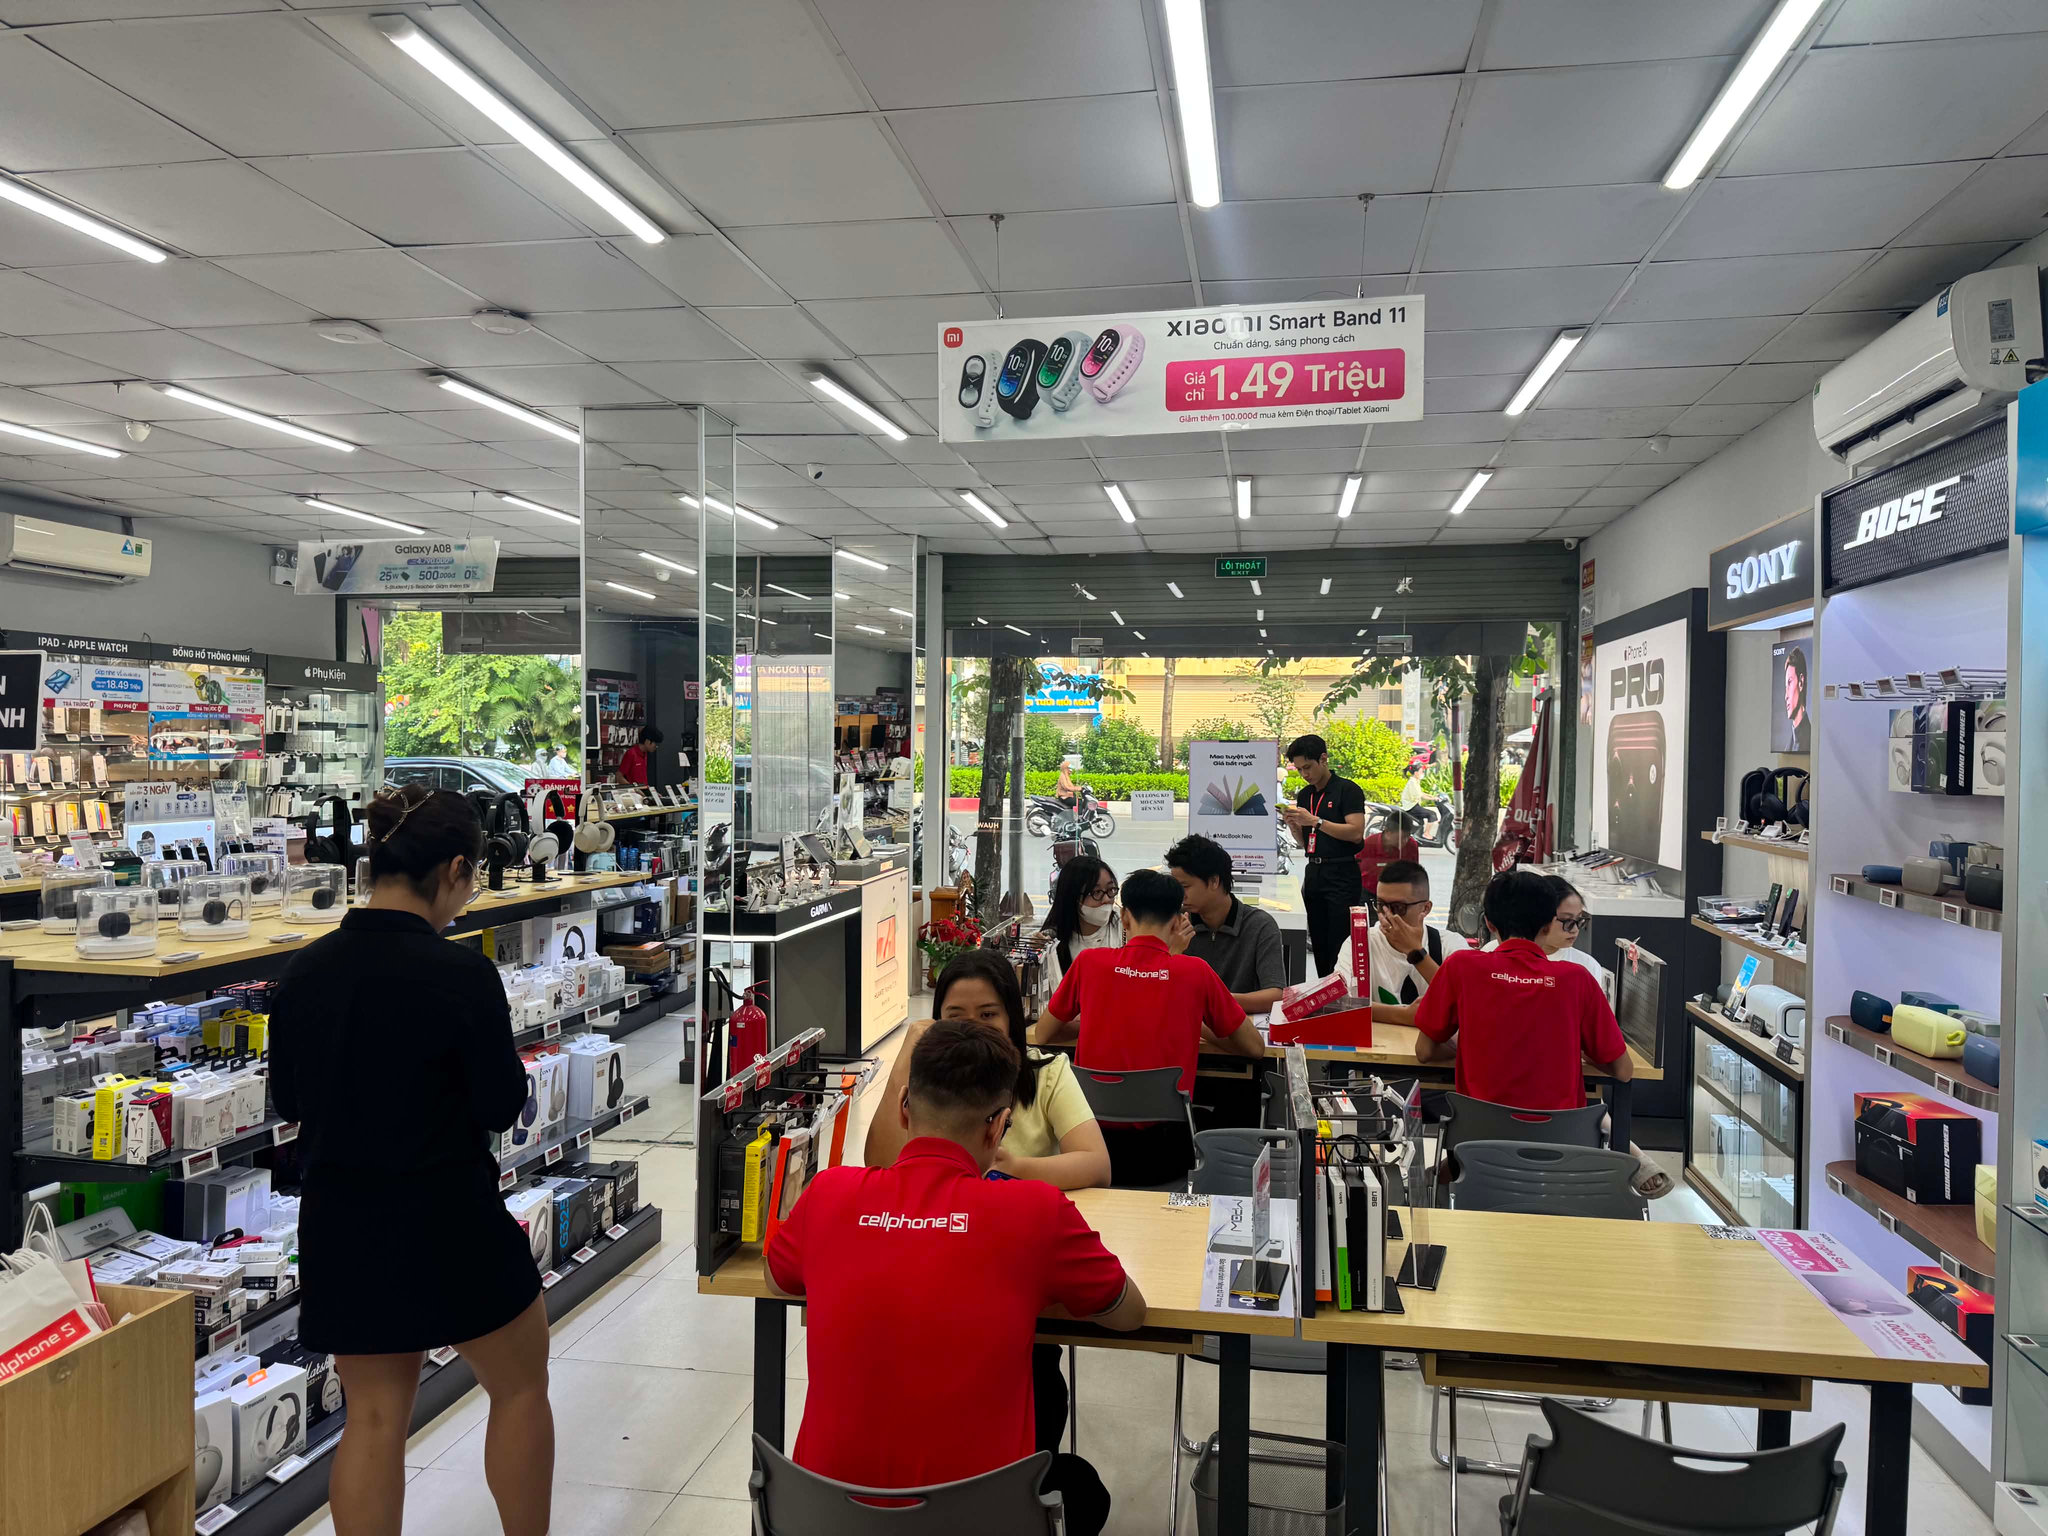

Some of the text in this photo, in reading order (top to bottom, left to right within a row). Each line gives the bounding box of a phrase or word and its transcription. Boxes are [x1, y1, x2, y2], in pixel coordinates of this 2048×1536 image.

[1269, 313, 1326, 331] Smart
[1332, 308, 1382, 327] Band
[1389, 307, 1406, 323] 11
[1246, 337, 1272, 349] dáng,
[1274, 336, 1296, 348] sáng
[1300, 335, 1330, 347] phong
[1332, 334, 1355, 344] cách
[1184, 371, 1206, 385] Giá
[1209, 361, 1386, 401] 1.49 Triệu
[1184, 388, 1205, 402] chỉ
[1179, 414, 1199, 423] Giảm
[1200, 413, 1220, 422] thêm
[1221, 412, 1258, 421] 100.000đ
[1278, 410, 1294, 418] kèm
[1295, 408, 1314, 418] Điện
[1363, 404, 1390, 413] Xiaomi
[1843, 476, 1960, 550] BOSE
[395, 544, 451, 555] Galaxy A08
[1221, 560, 1261, 570] LỐI THOÁT
[1727, 540, 1800, 599] SONY
[38, 637, 59, 647] IPAD
[68, 640, 95, 650] APPLE
[98, 642, 128, 652] WATCH
[1774, 648, 1786, 656] SONY
[173, 647, 250, 662] ĐỒNG HỒ THÔNG MINH
[312, 668, 346, 681] Phụ Kiện
[107, 680, 129, 689] 18.49
[1610, 658, 1664, 711] PRO
[1959, 743, 1965, 752] IS
[143, 786, 148, 795] 3
[150, 783, 172, 795] NGÀY
[1491, 972, 1555, 987] cellphoneS
[229, 1186, 246, 1195] SONY
[858, 1212, 968, 1232] cellphoneS
